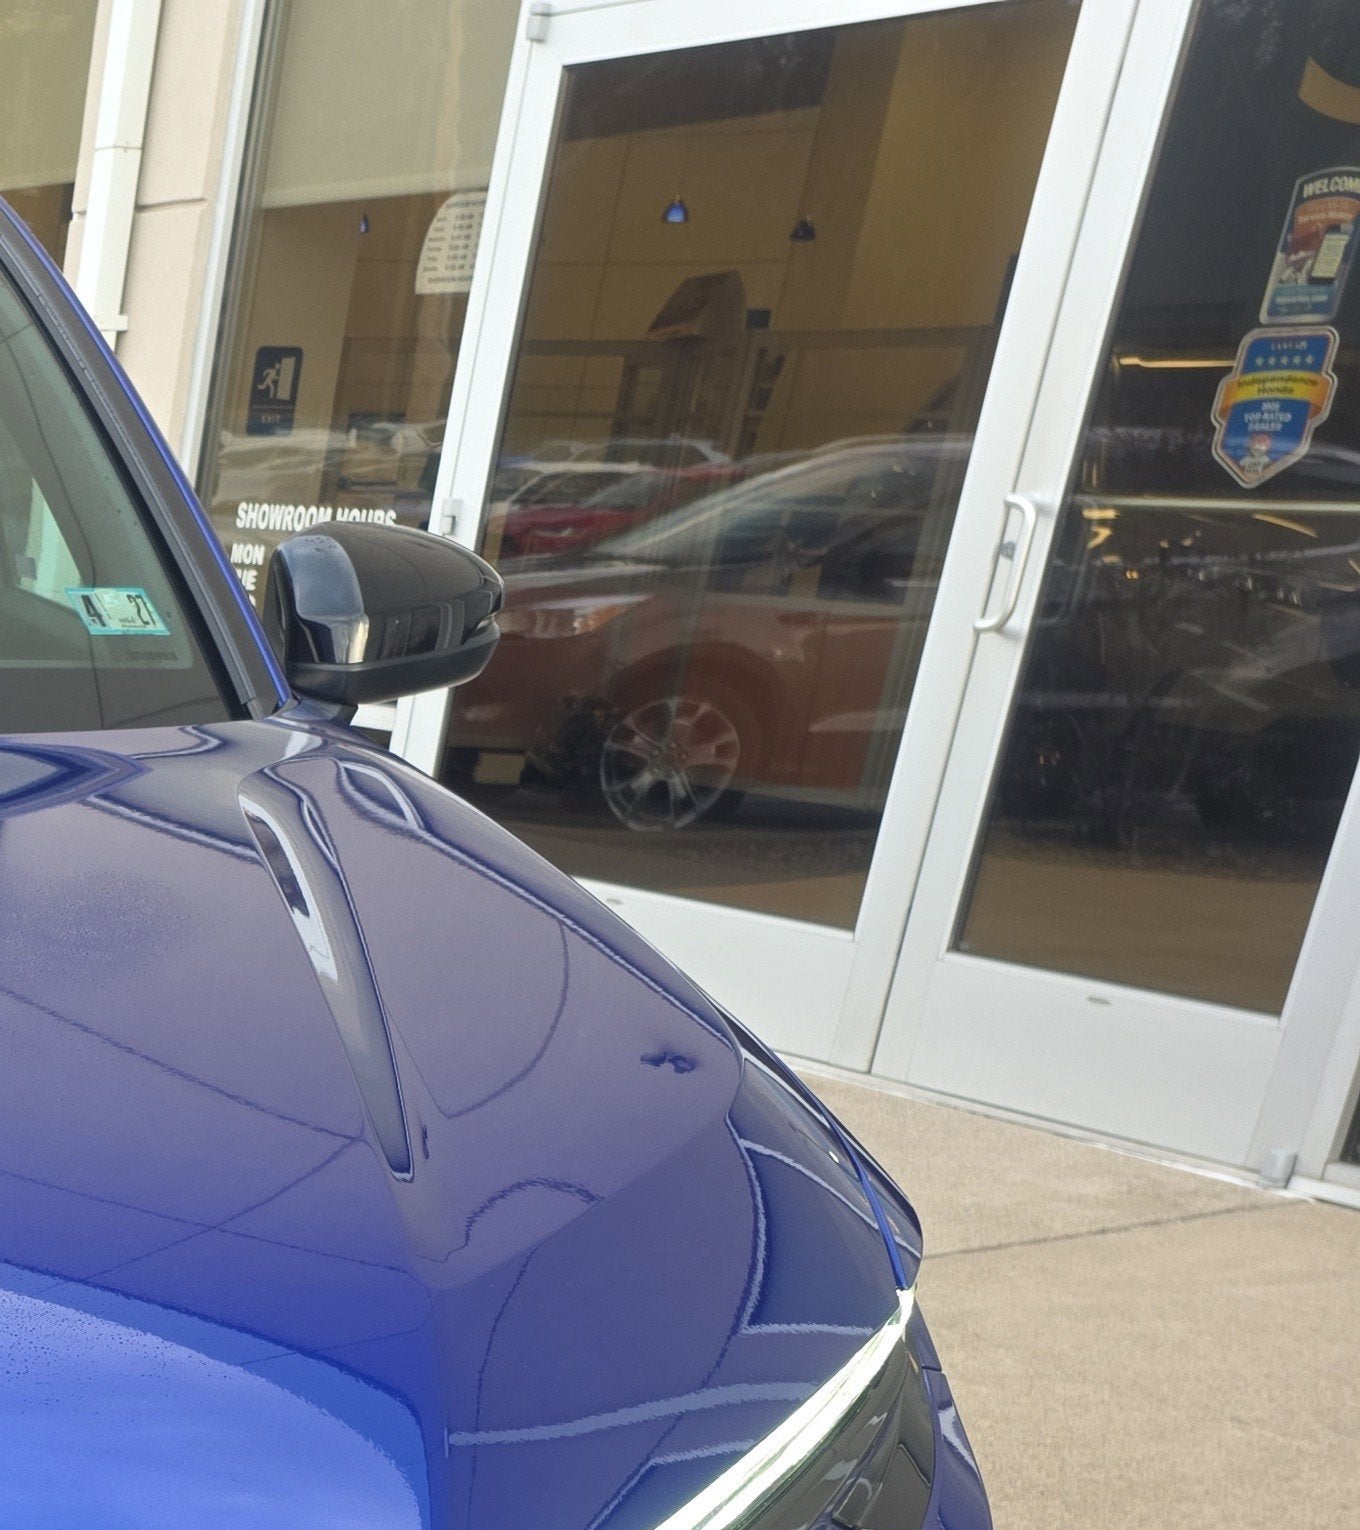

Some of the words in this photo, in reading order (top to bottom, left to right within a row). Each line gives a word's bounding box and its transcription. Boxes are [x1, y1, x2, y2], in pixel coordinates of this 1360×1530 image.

[236, 501, 333, 531] SHOWROOM
[230, 543, 265, 565] MON
[81, 595, 107, 627] 4
[126, 594, 157, 626] 27
